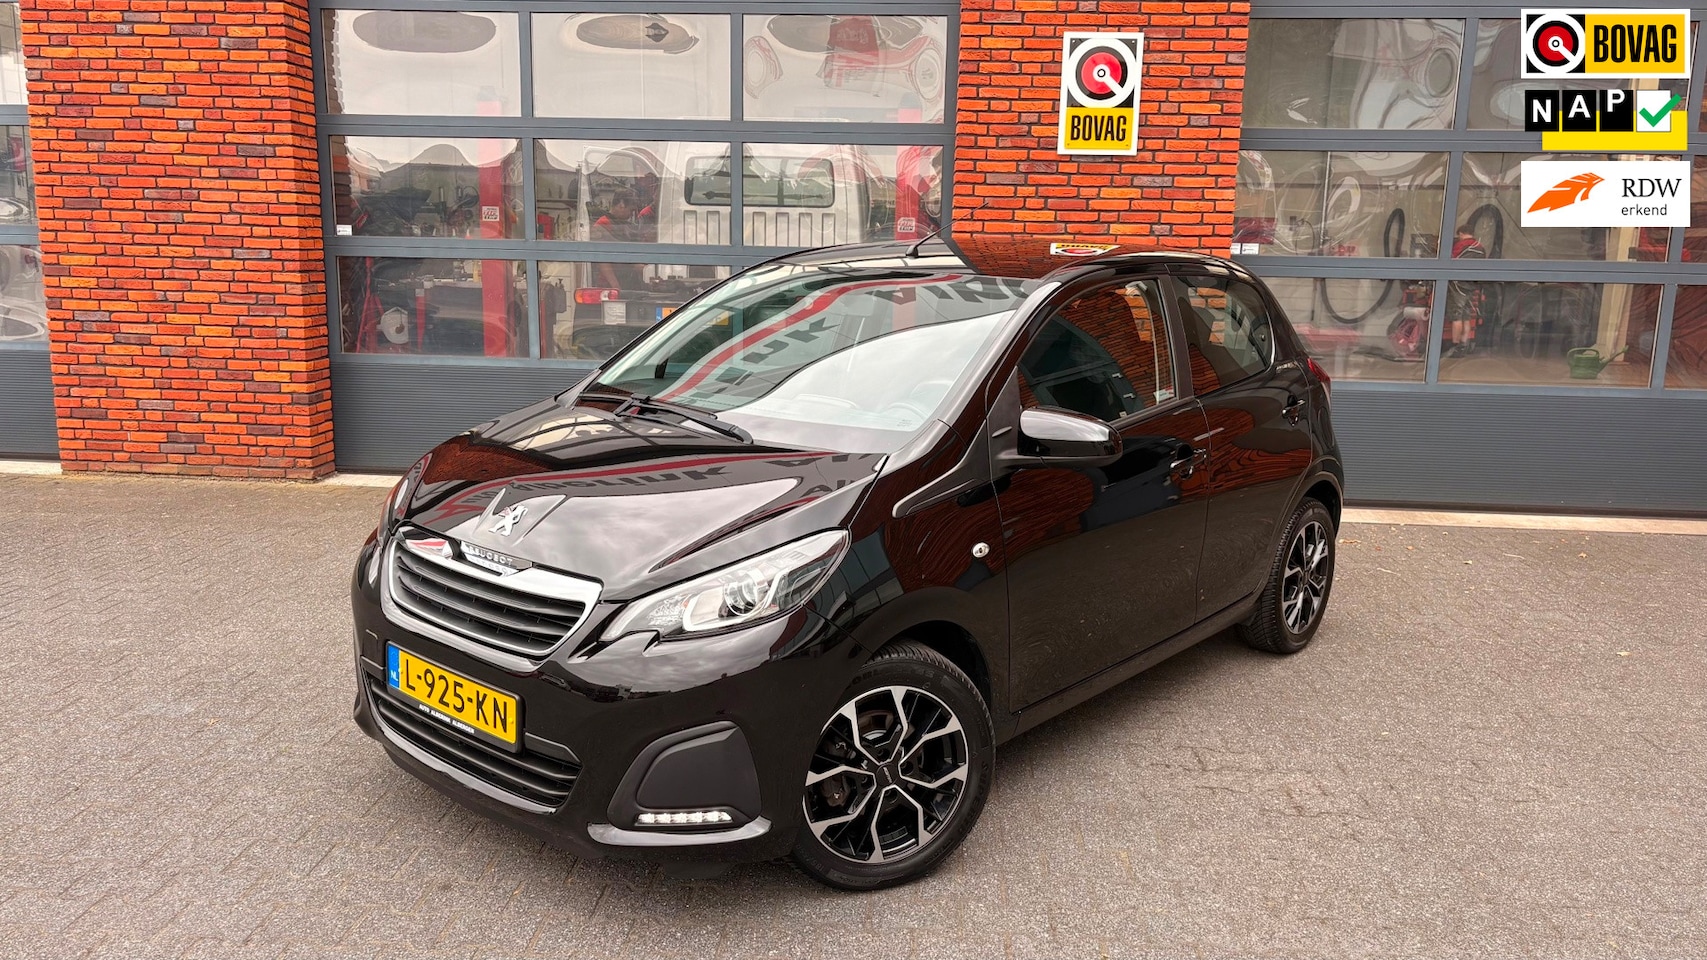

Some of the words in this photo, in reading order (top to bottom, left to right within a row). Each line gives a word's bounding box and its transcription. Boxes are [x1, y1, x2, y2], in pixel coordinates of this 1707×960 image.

[1070, 114, 1127, 142] BOVAG
[390, 669, 399, 681] NL
[406, 658, 508, 733] L-925-KN
